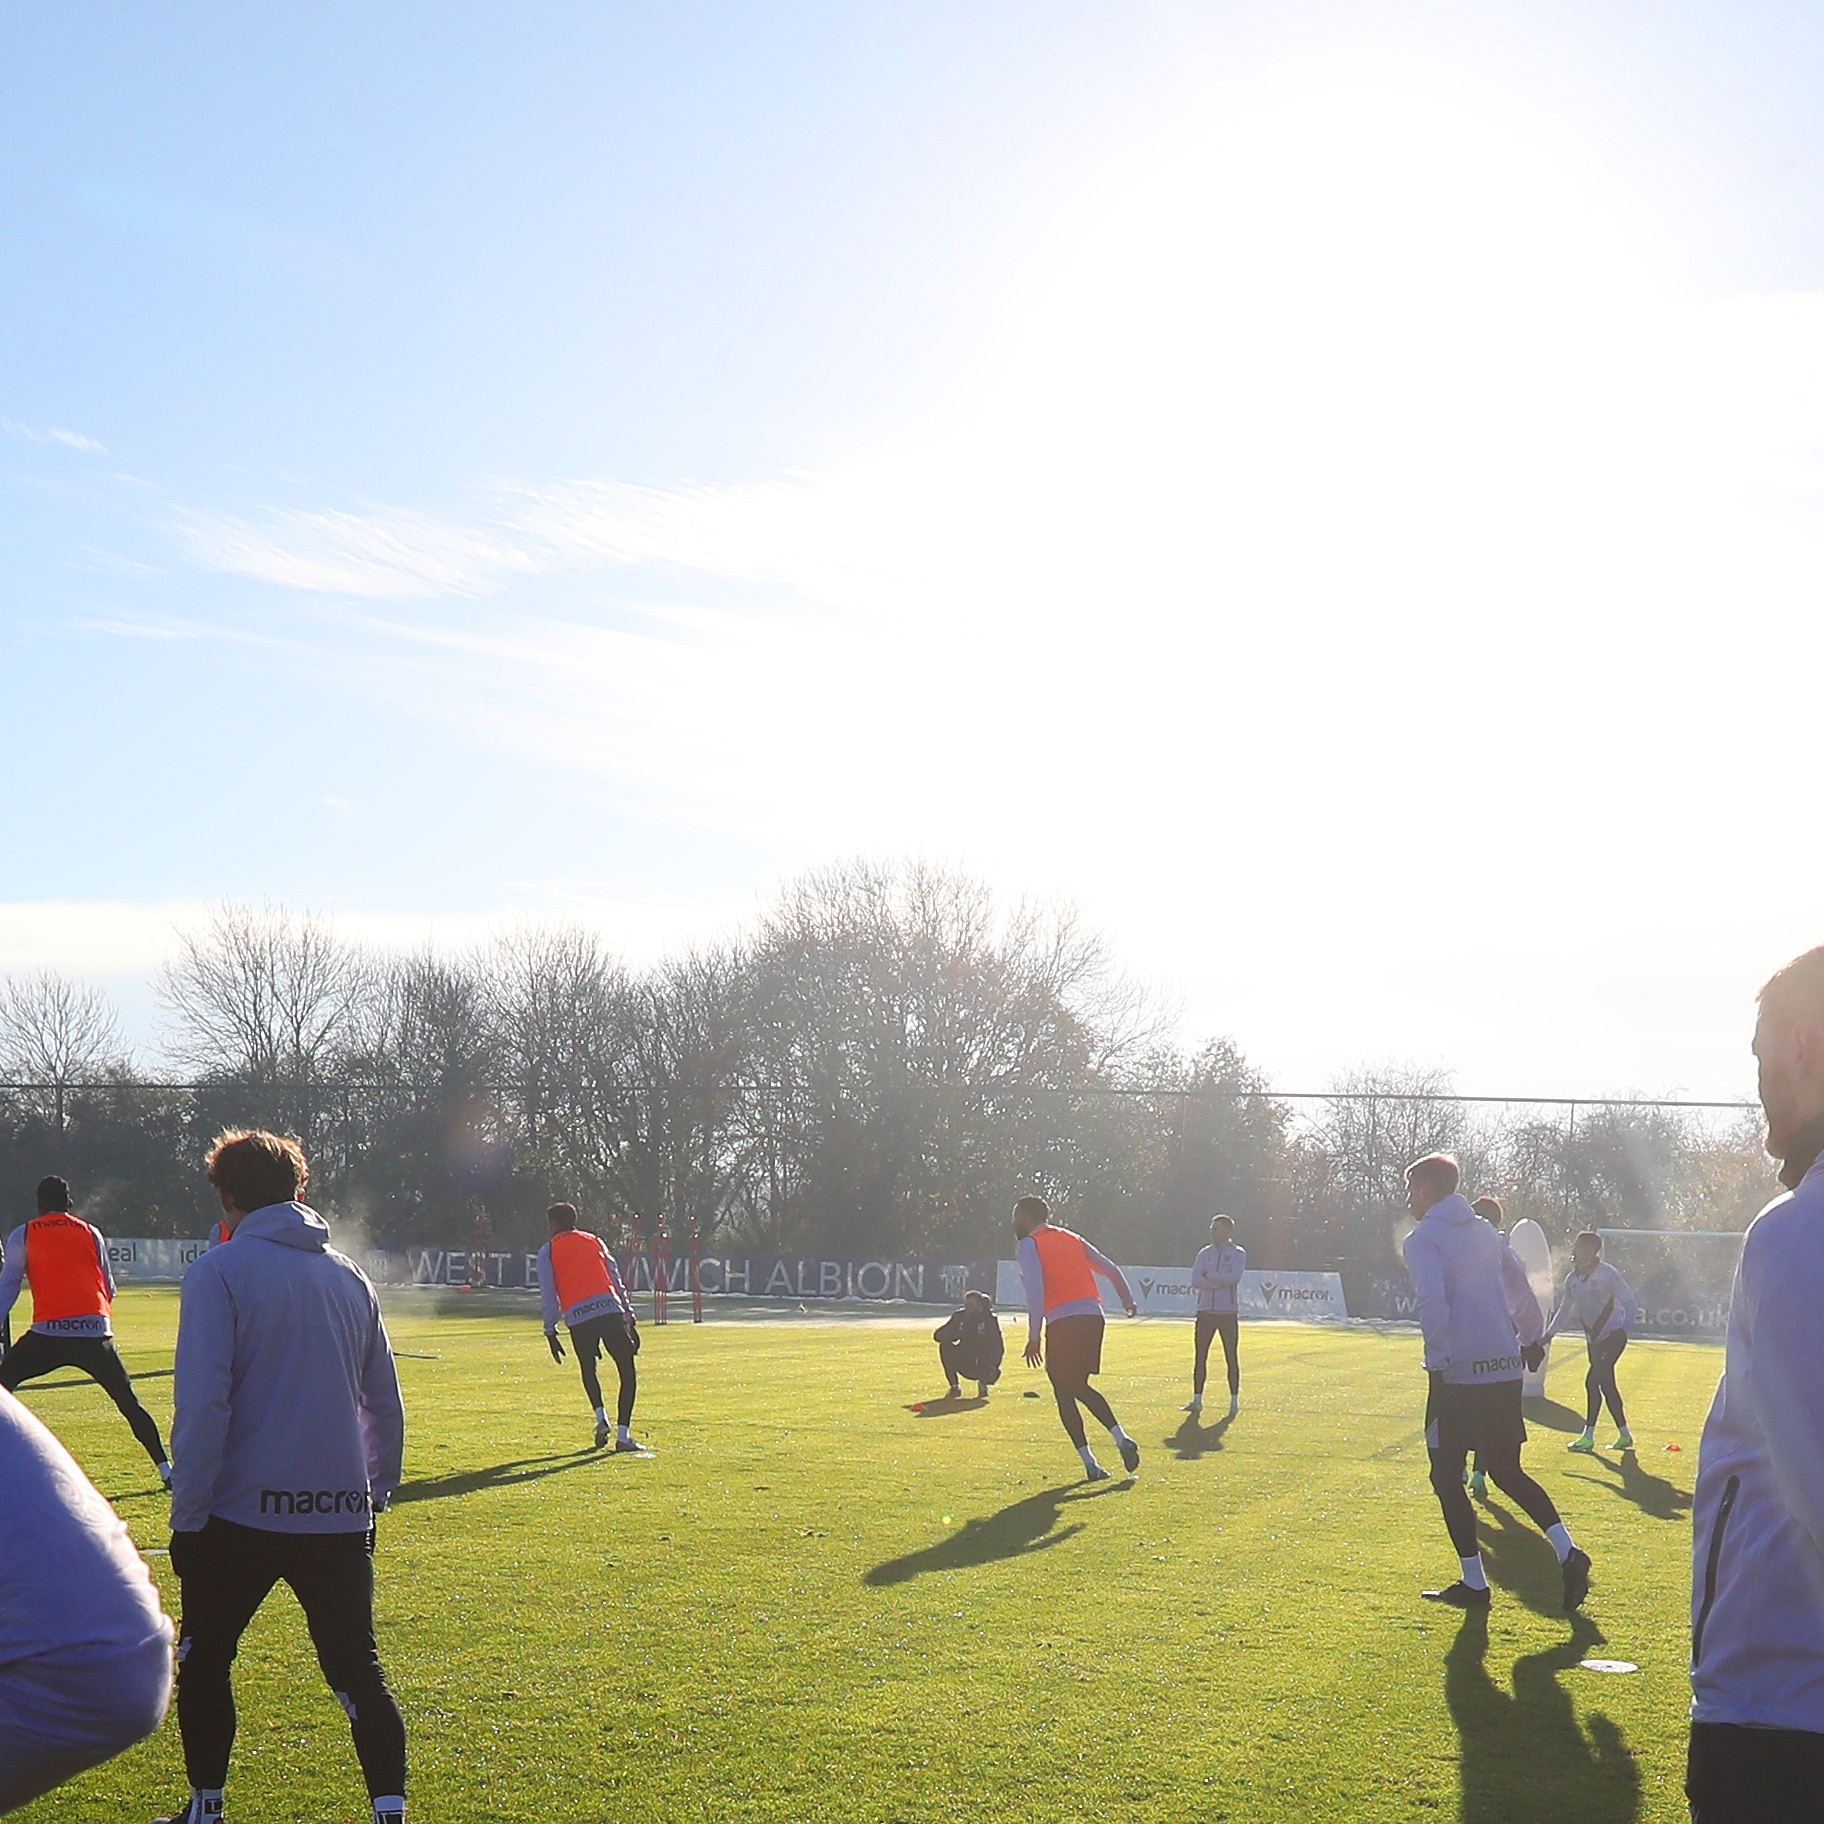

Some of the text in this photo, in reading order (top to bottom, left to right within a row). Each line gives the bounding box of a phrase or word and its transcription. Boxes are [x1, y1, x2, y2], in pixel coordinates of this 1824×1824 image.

[408, 1250, 512, 1287] WEST
[764, 1258, 925, 1299] ALBION
[572, 1299, 615, 1319] macron
[46, 1319, 102, 1331] macron
